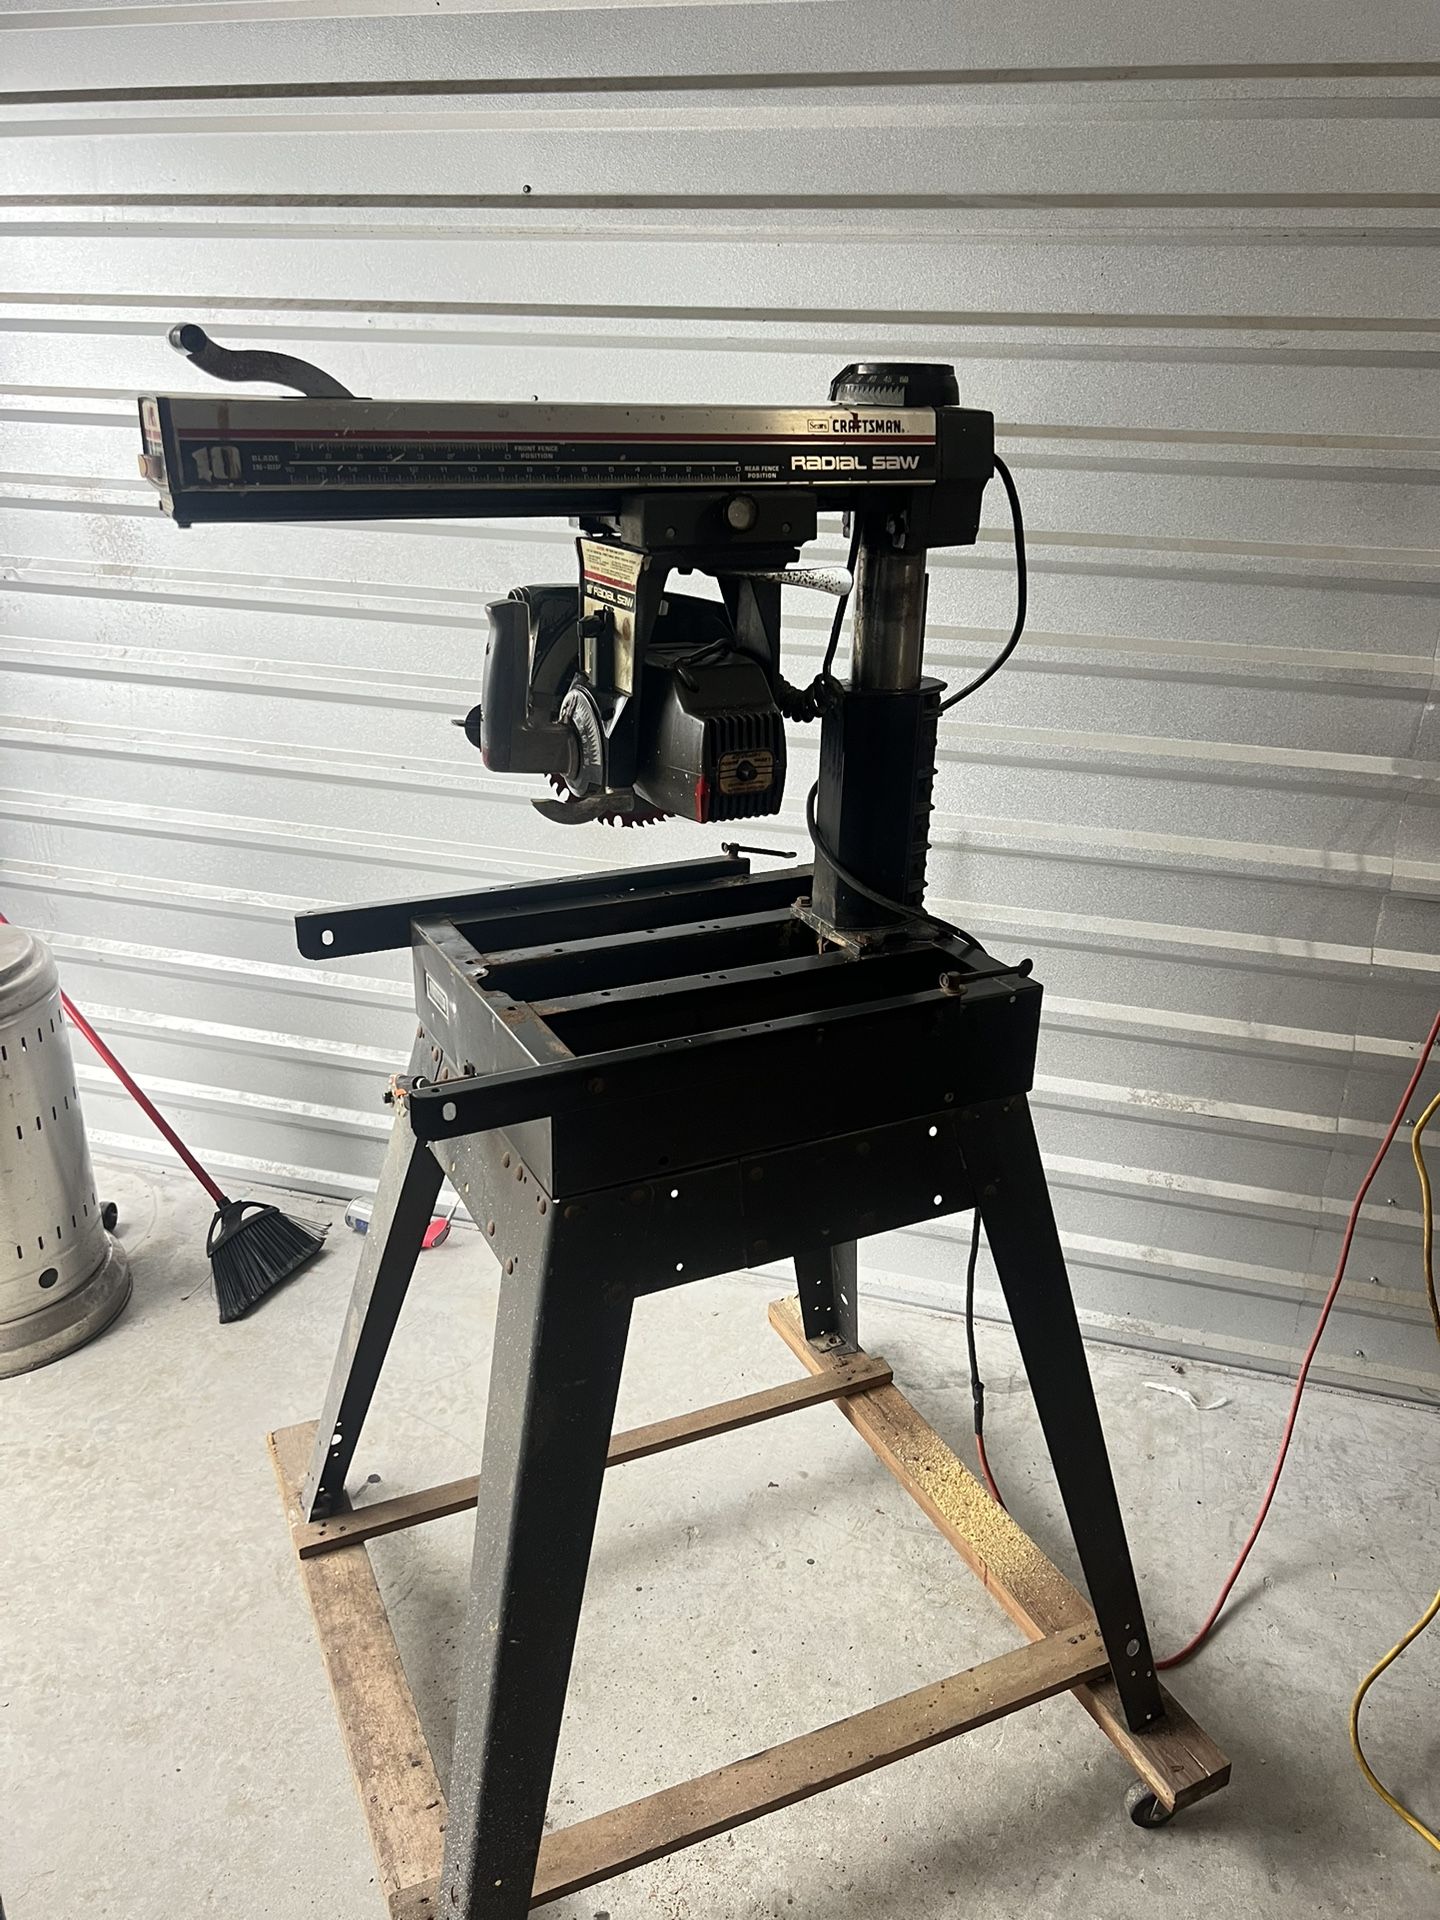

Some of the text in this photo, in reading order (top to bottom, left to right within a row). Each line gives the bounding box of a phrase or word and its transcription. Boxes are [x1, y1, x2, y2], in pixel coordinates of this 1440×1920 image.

[809, 419, 901, 433] Sears CRAFTSMAN
[251, 454, 279, 462] BLADE
[520, 452, 553, 460] POSITION
[191, 446, 242, 482] 10
